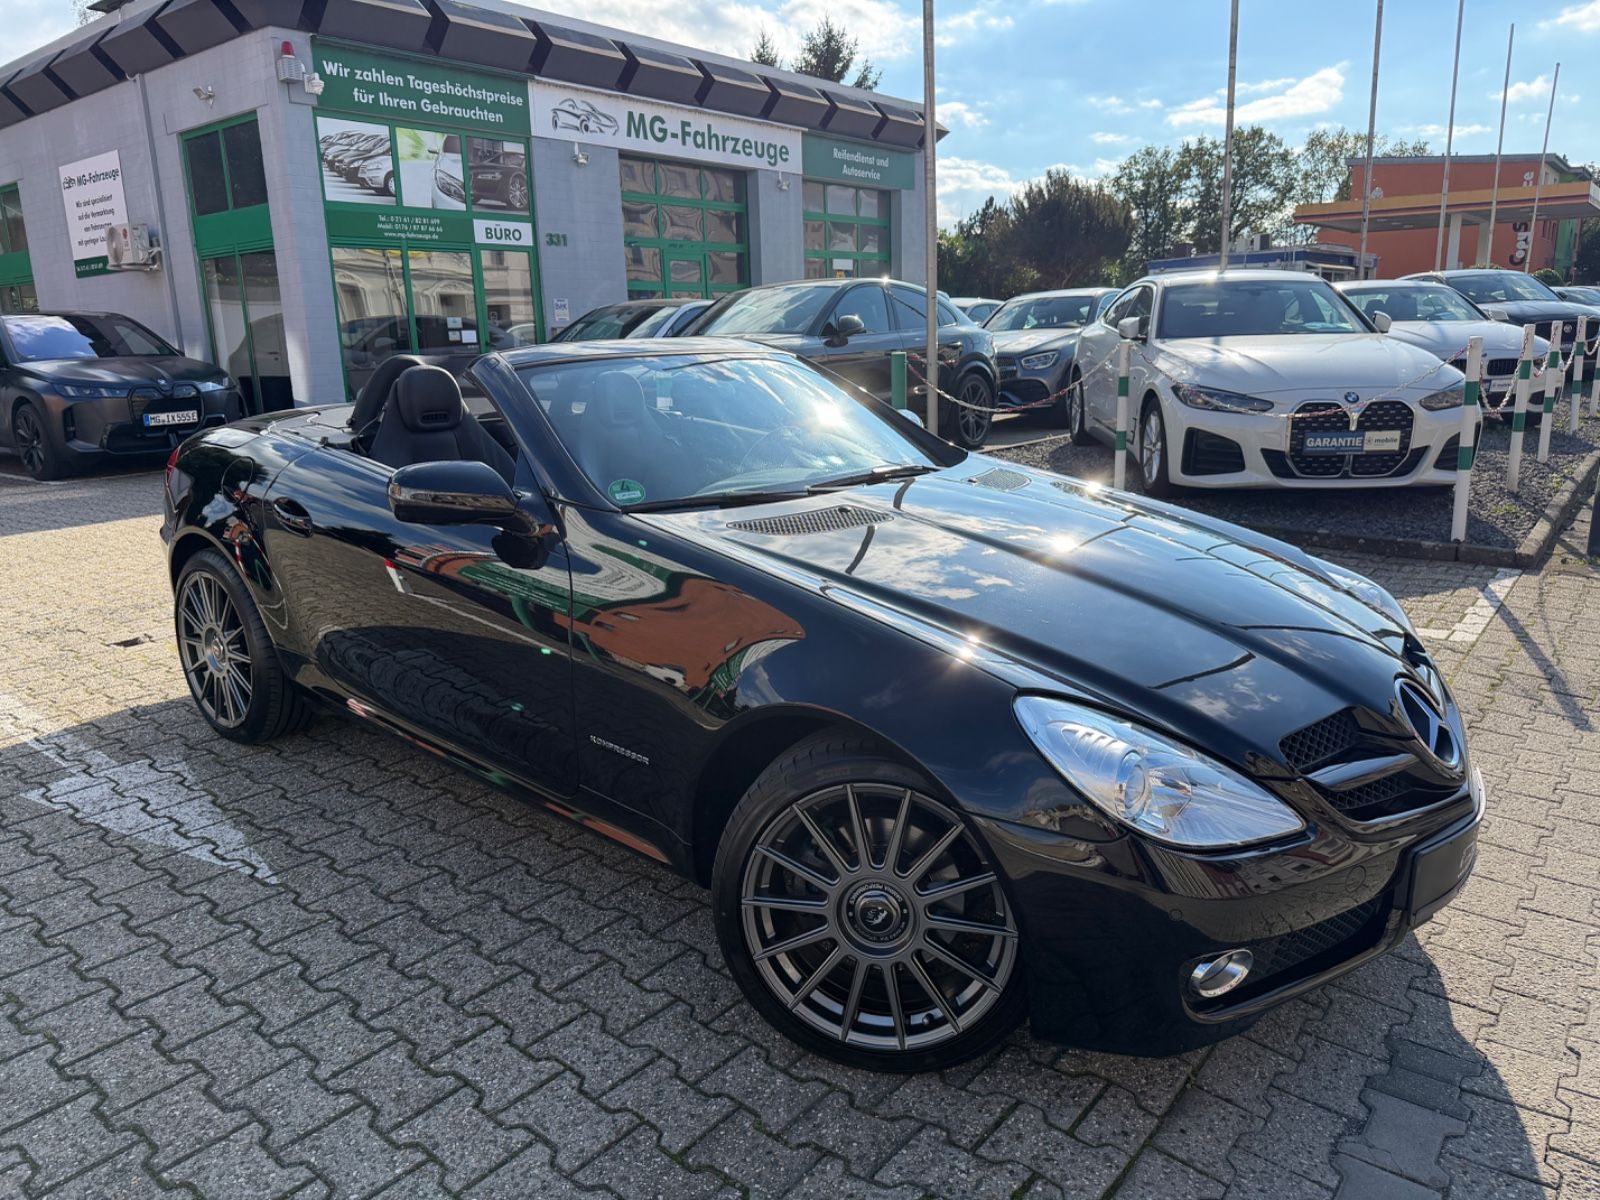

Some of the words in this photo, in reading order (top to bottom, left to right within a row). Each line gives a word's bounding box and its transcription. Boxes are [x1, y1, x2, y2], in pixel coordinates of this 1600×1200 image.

[322, 60, 350, 78] Wir
[354, 68, 404, 87] zahlen
[407, 74, 524, 106] Tageshöchstpreise
[353, 87, 375, 104] für
[379, 92, 417, 111] Ihren
[421, 99, 504, 123] Gebrauchten
[626, 110, 790, 167] MG-Fahrzeuge
[833, 147, 875, 165] Reifendienst
[876, 157, 889, 168] und
[76, 168, 120, 187] MG-Fahrzeuge
[842, 164, 881, 180] Autoservice
[484, 223, 522, 242] BÜRO
[545, 233, 568, 247] 331
[150, 415, 161, 424] MG
[1306, 437, 1363, 447] GARANTIE
[590, 735, 650, 765] KOMPRESSOR
